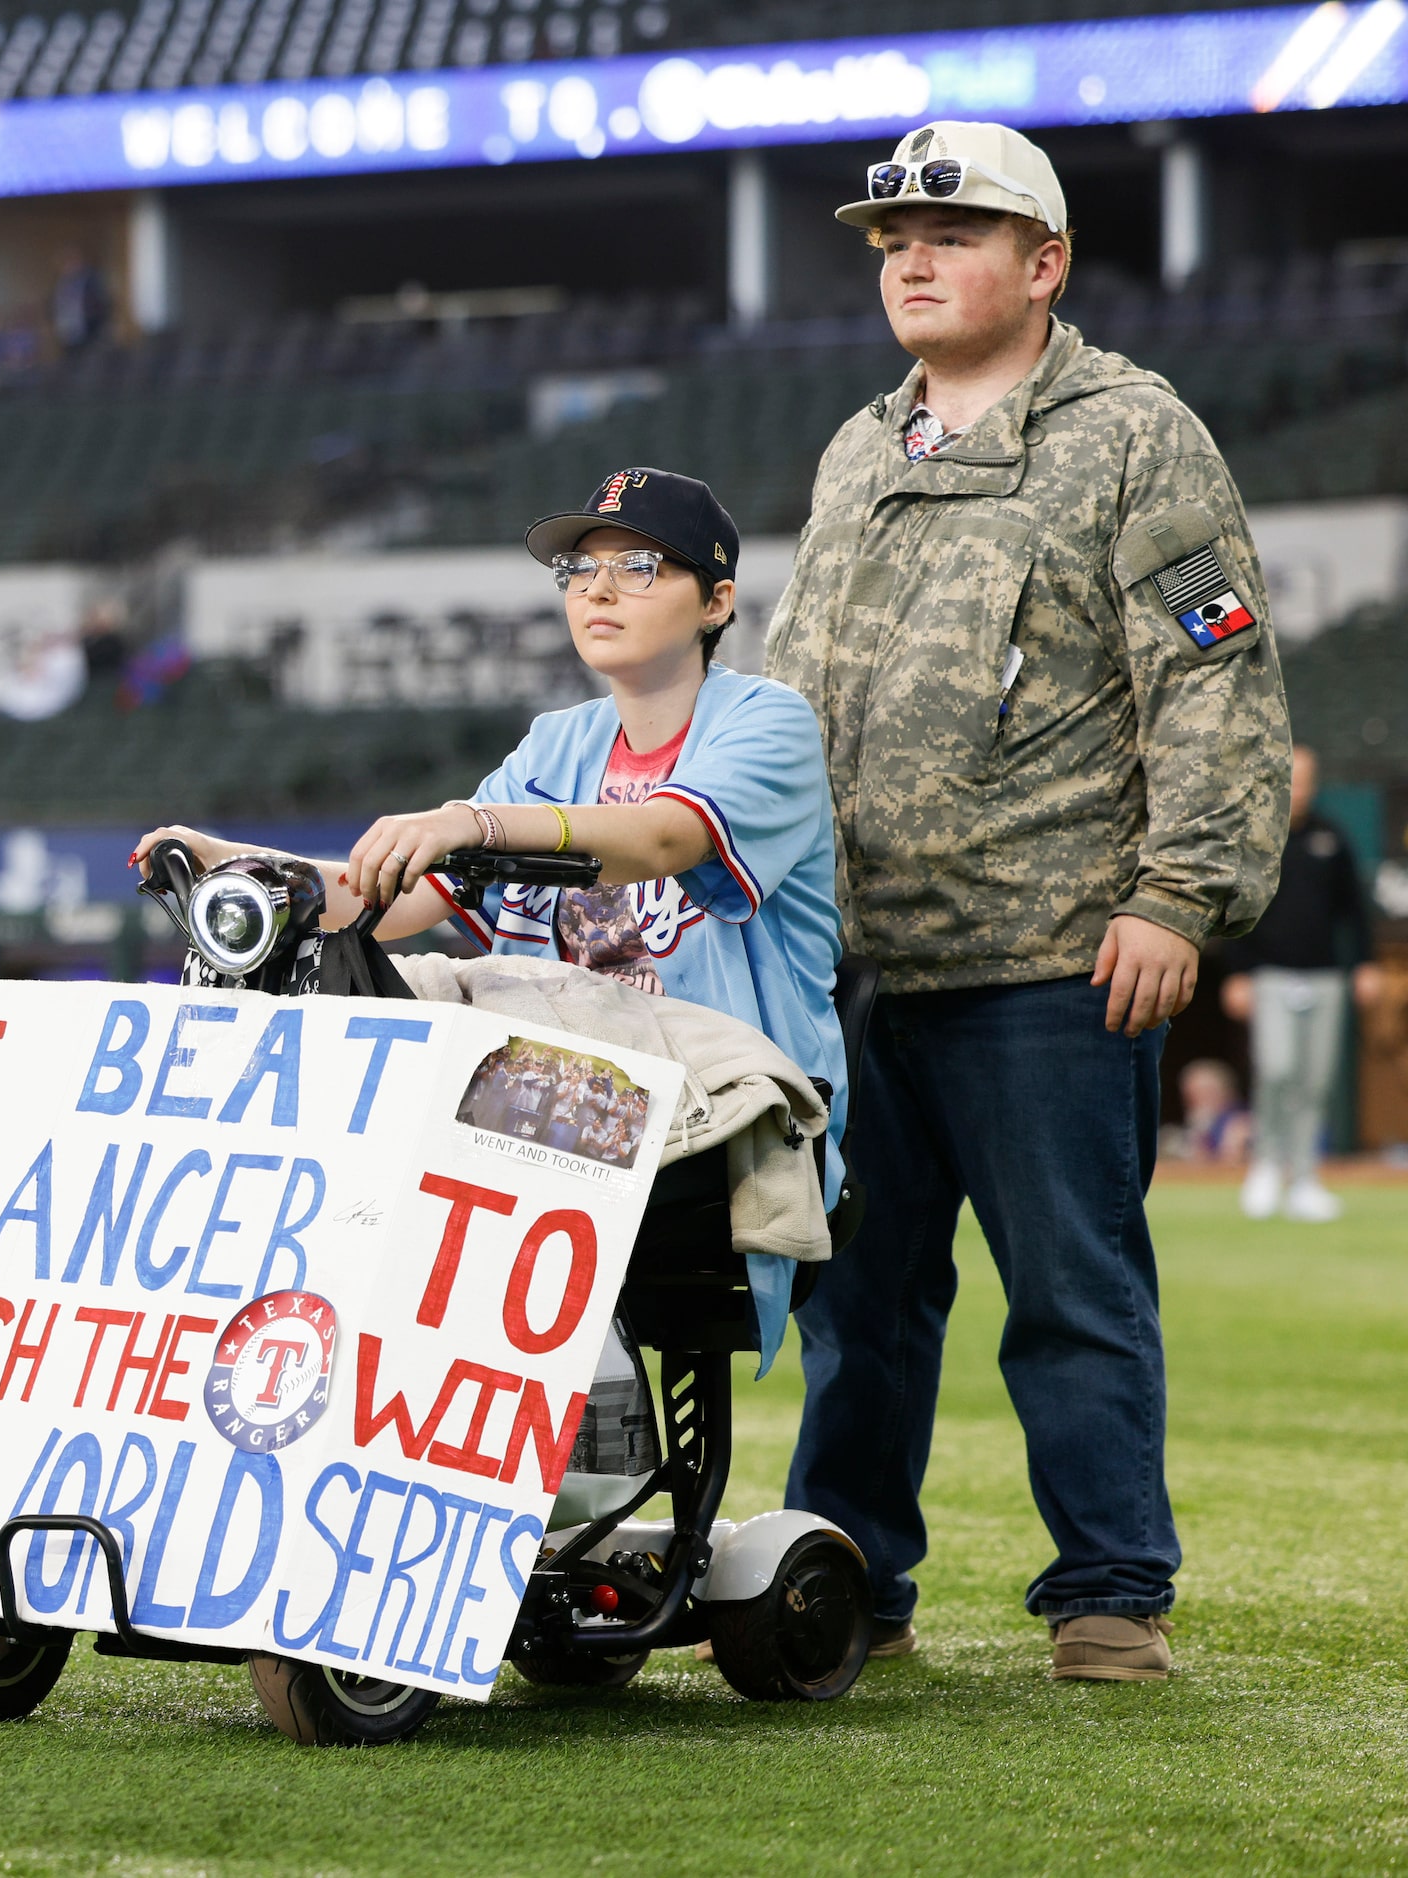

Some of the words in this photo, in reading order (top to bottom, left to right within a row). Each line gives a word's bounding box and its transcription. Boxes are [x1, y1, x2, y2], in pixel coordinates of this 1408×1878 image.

[598, 470, 648, 513] T
[77, 1001, 432, 1133] BEAT
[474, 1132, 515, 1153] WENT
[516, 1145, 547, 1162] AND
[552, 1154, 589, 1175] TOOK
[592, 1166, 611, 1182] IT!
[417, 1173, 596, 1354] TO
[74, 1307, 217, 1420] THE
[238, 1297, 335, 1340] TEXAS
[212, 1378, 327, 1445] RANGERS
[256, 1338, 310, 1409] T
[355, 1333, 588, 1494] WIN
[273, 1462, 544, 1684] SERIES
